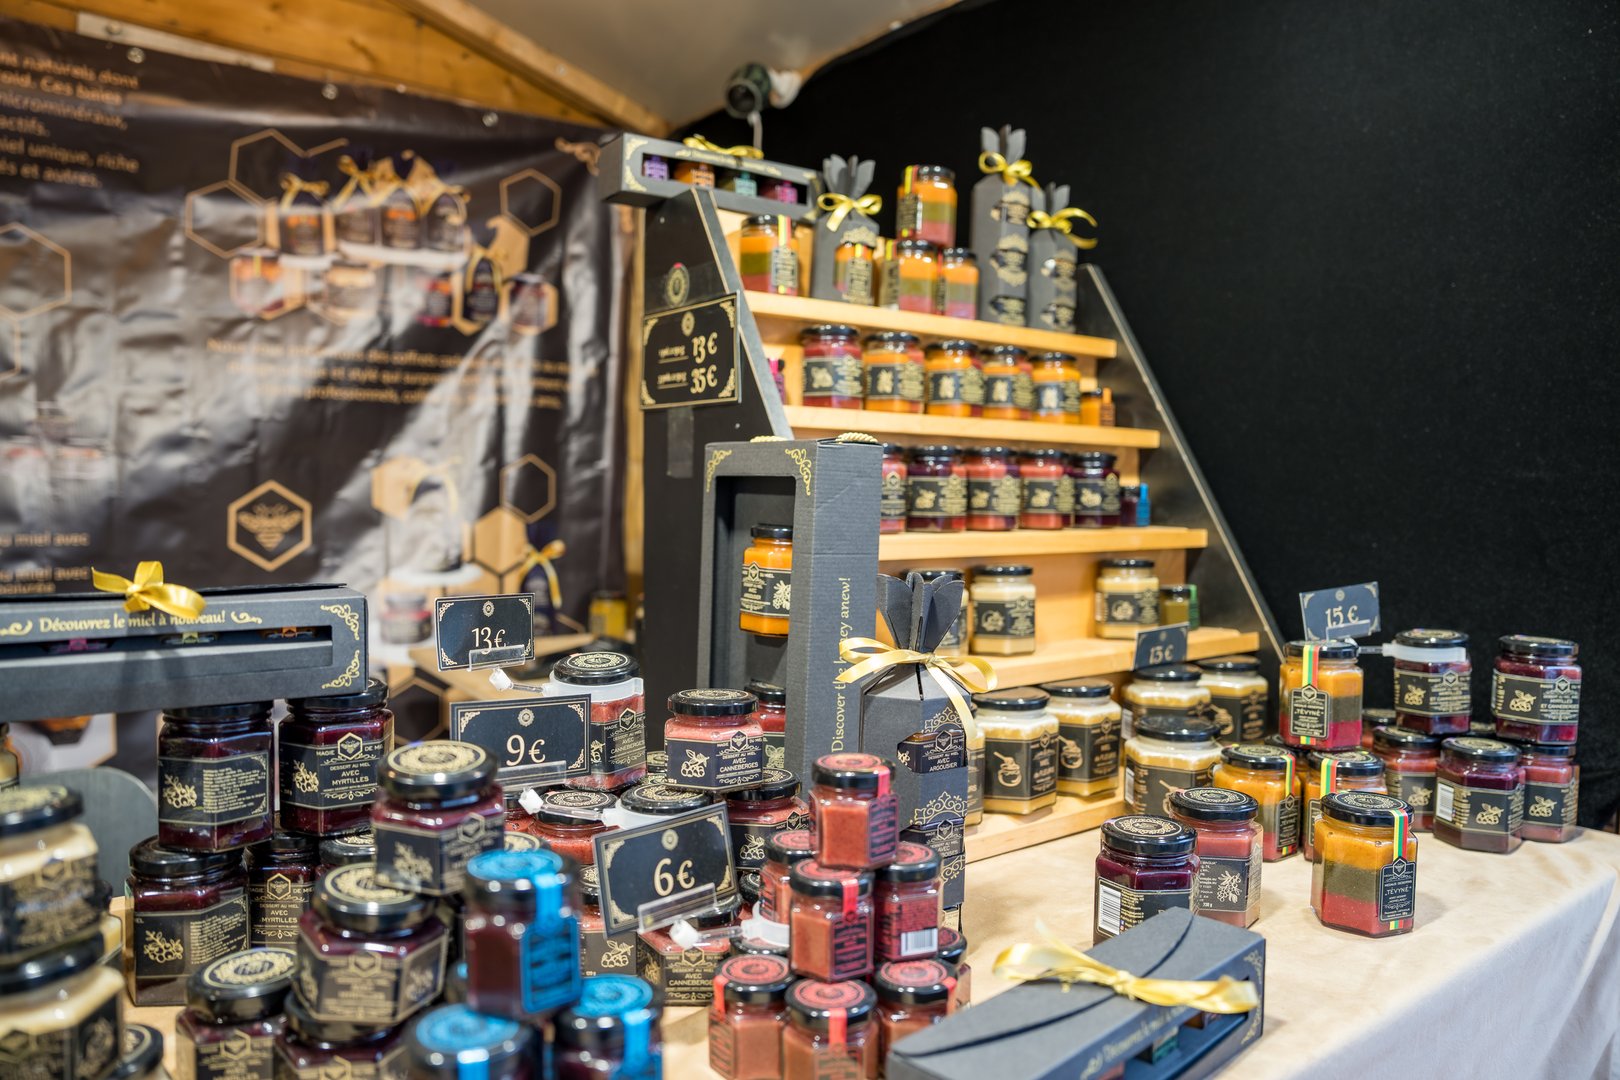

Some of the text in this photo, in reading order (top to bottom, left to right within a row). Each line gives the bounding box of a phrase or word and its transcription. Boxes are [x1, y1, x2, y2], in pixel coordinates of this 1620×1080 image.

[692, 332, 718, 364] 13€
[838, 577, 852, 619] anew!
[38, 615, 111, 634] Découvrez
[112, 613, 126, 630] le
[127, 610, 156, 628] miel
[158, 611, 167, 626] à
[1325, 605, 1360, 629] 15€
[471, 626, 506, 655] 13€
[831, 692, 846, 753] Discover
[506, 734, 546, 767] 9€
[622, 736, 635, 745] AVEC
[720, 761, 759, 773] CANNEBERGES
[733, 757, 747, 765] AVEC
[937, 757, 951, 765] AVEC
[331, 775, 370, 786] MYRTILLES
[341, 769, 360, 778] AVEC
[653, 858, 696, 897] 6€
